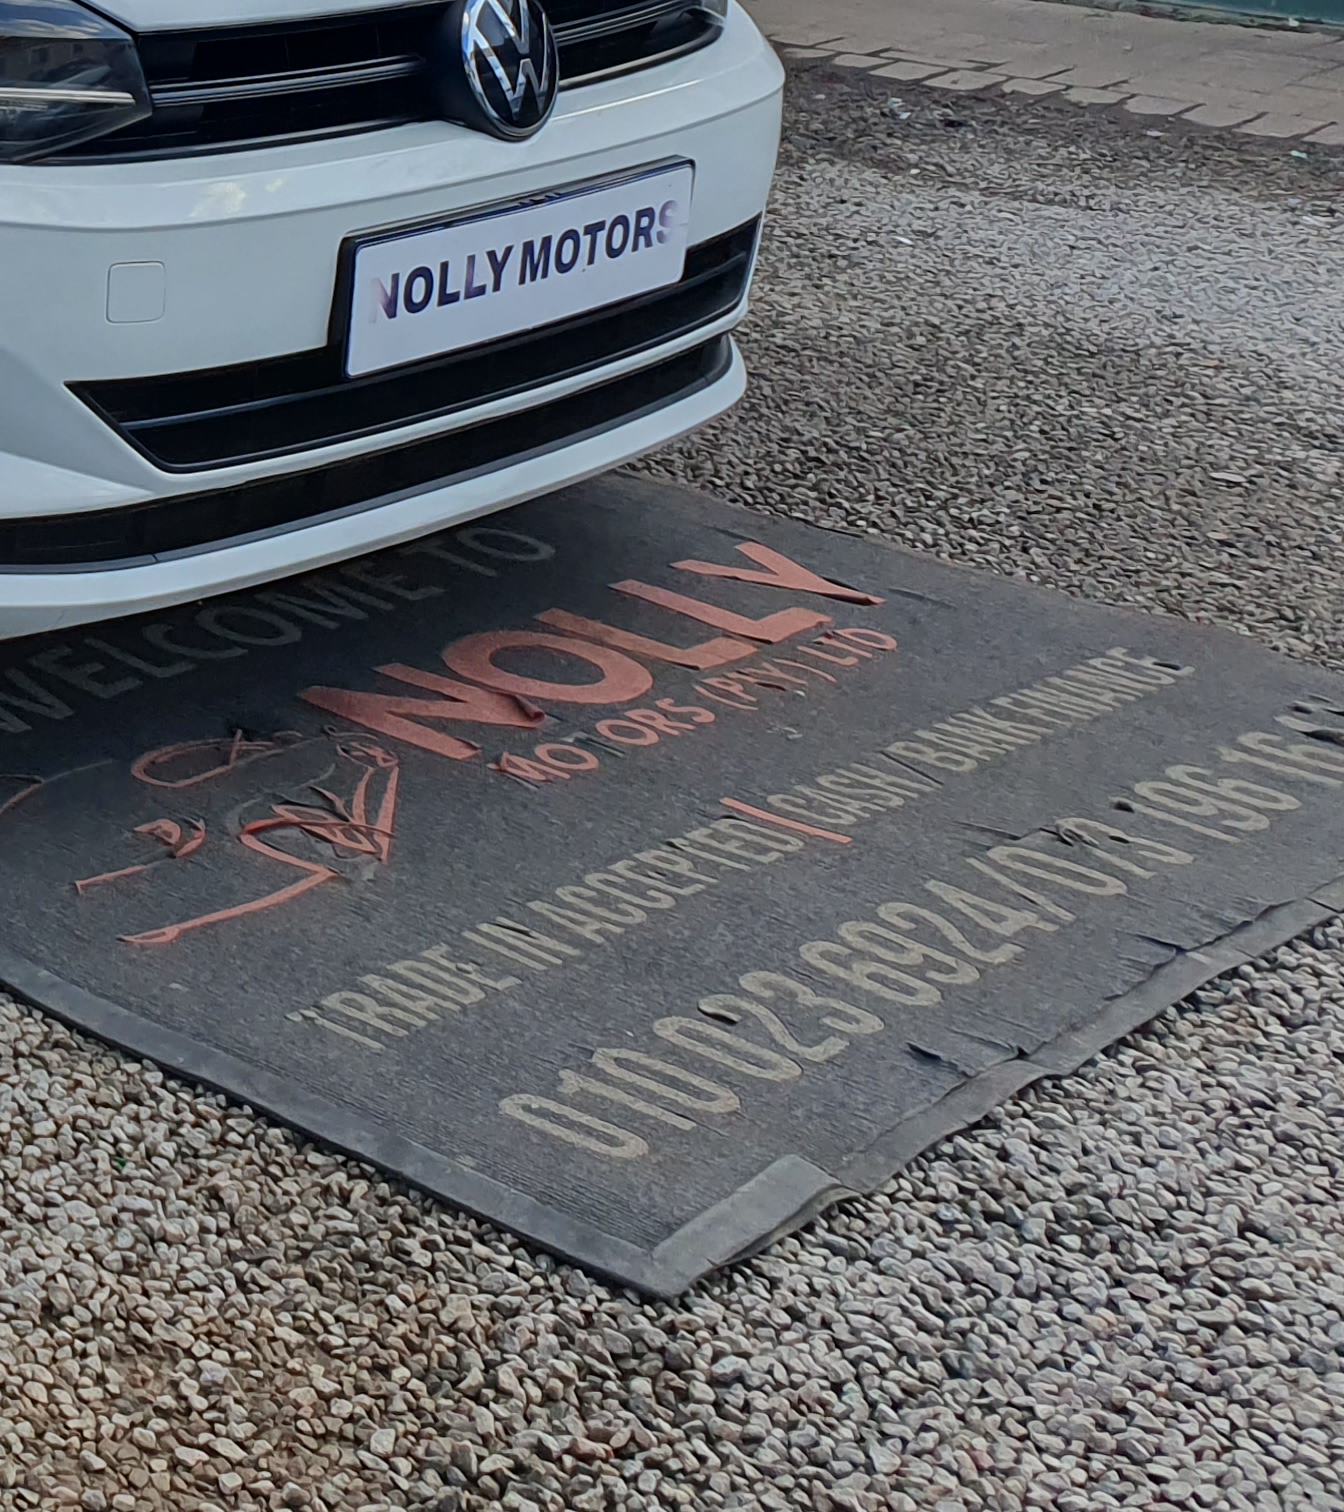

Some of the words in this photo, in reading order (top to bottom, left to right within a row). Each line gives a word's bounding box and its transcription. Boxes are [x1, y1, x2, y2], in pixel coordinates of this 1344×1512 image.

[369, 244, 513, 324] NOLLY
[518, 199, 679, 286] MOTORS
[297, 541, 885, 761] NOLLY
[404, 526, 556, 577] TO
[285, 942, 523, 1051] TRADE
[461, 916, 582, 971] IN
[526, 816, 806, 946] ACCEPTED
[990, 646, 1196, 728] FINANCE
[499, 1048, 740, 1160] 010
[652, 970, 885, 1083] 023
[1109, 764, 1302, 843] 196
